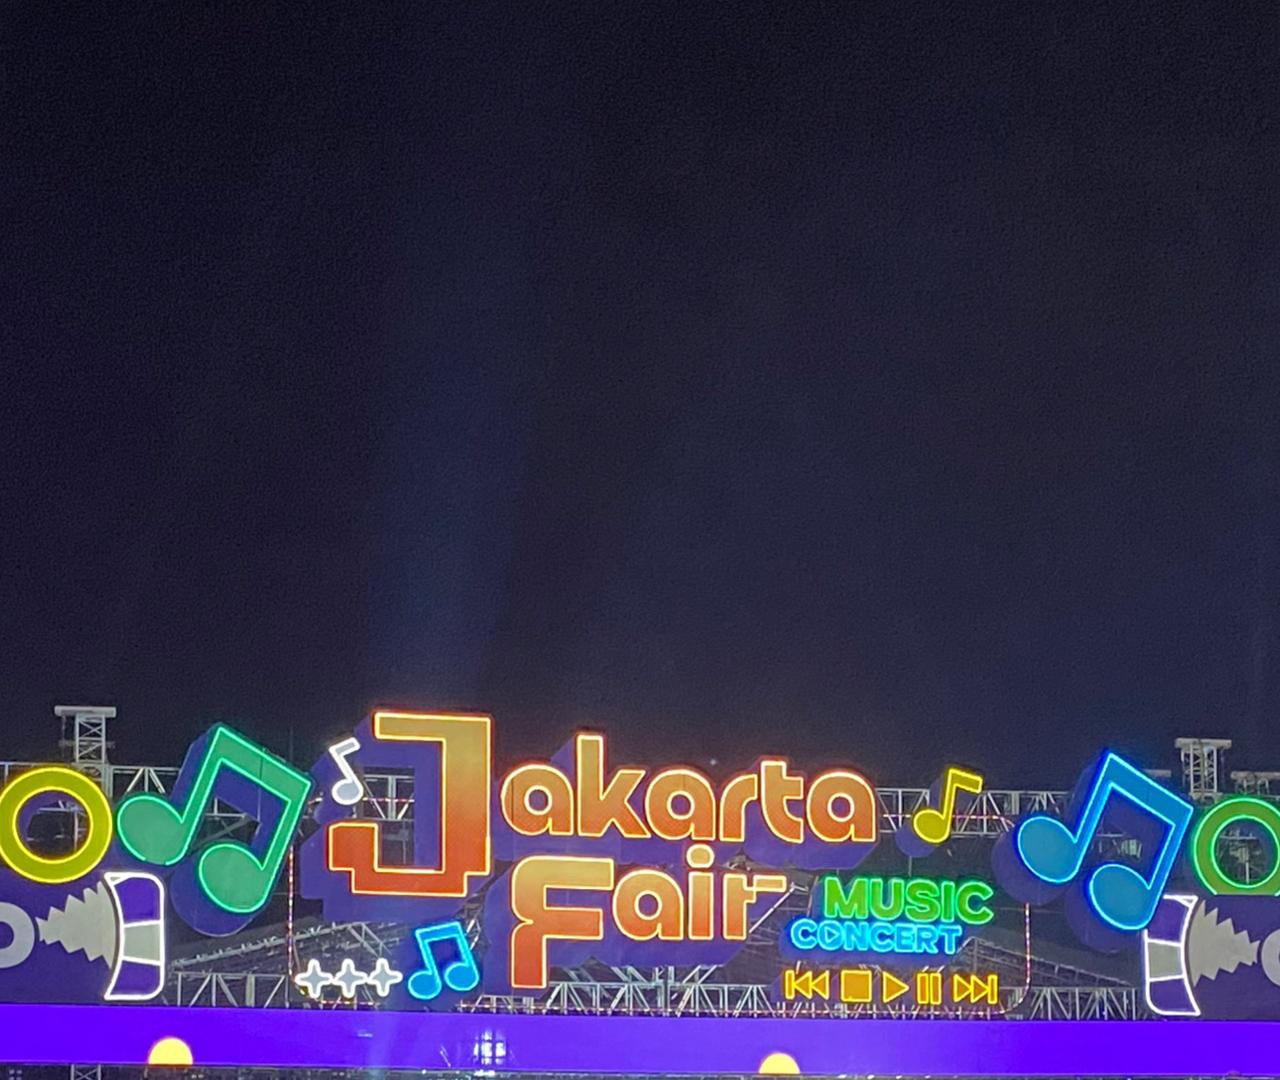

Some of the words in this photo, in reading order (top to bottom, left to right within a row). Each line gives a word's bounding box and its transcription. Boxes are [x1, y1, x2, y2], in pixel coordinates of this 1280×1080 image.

[328, 711, 877, 897] Jakarta
[511, 844, 788, 989] Fair
[789, 917, 963, 955] CONCERT
[824, 876, 995, 925] MUSIC
